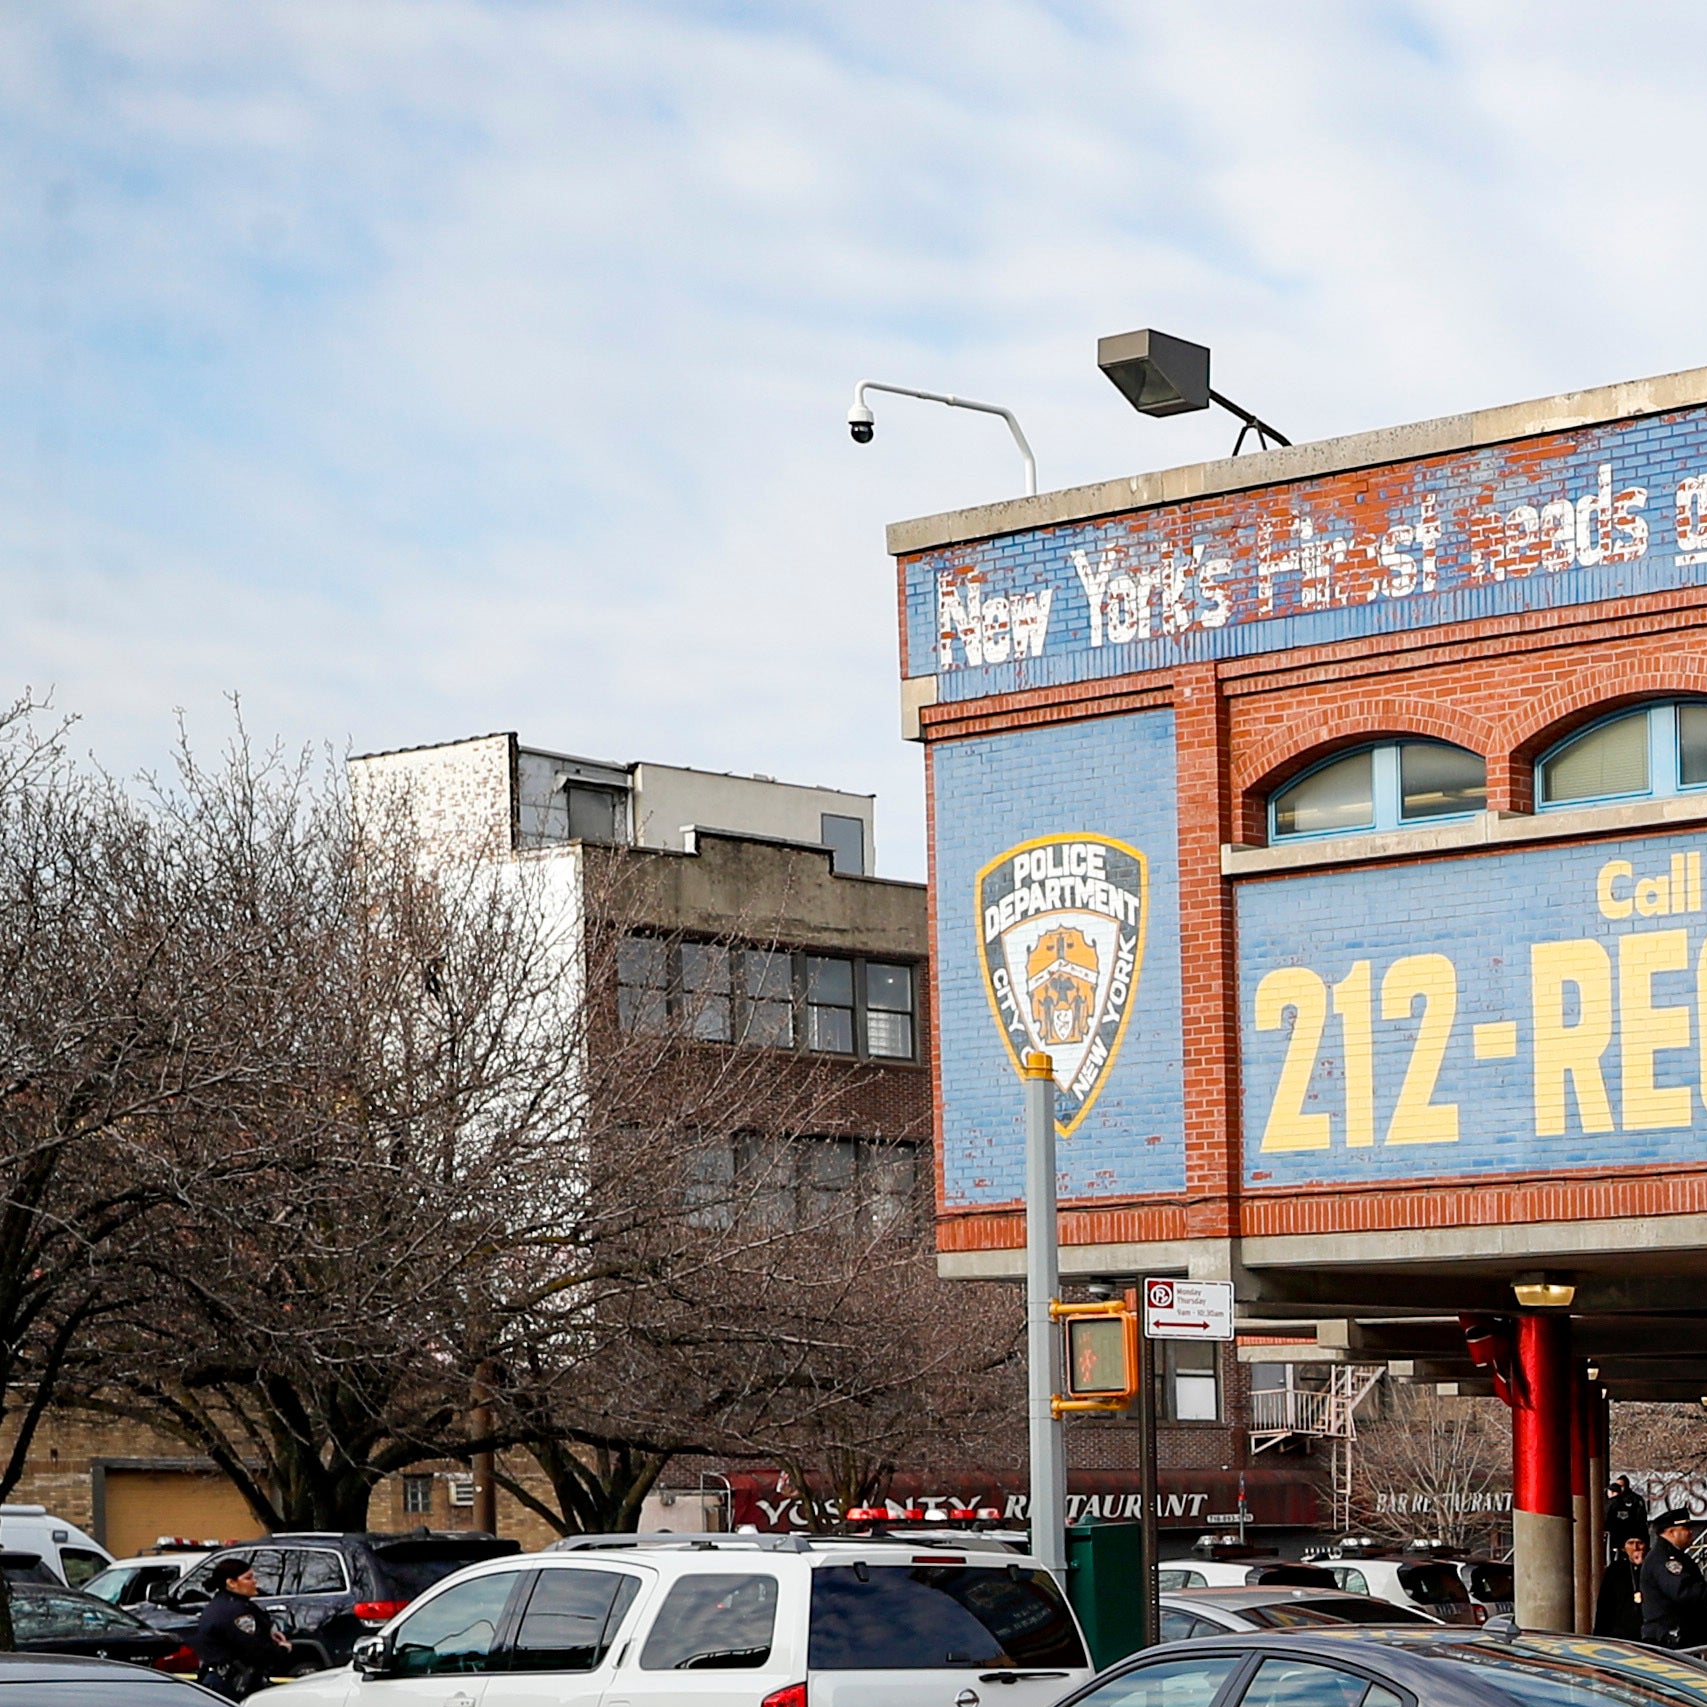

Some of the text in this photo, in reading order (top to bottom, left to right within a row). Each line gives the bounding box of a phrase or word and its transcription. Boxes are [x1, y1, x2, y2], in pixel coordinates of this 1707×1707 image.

[938, 566, 1052, 671] New
[1070, 541, 1233, 648] York's
[1012, 842, 1108, 890] POLICE
[1596, 850, 1703, 920] Call
[983, 876, 1140, 944] DEPARTMENT
[992, 967, 1026, 1034] CITY
[1071, 934, 1137, 1102] NEW YORK
[1376, 1492, 1408, 1515] BAR
